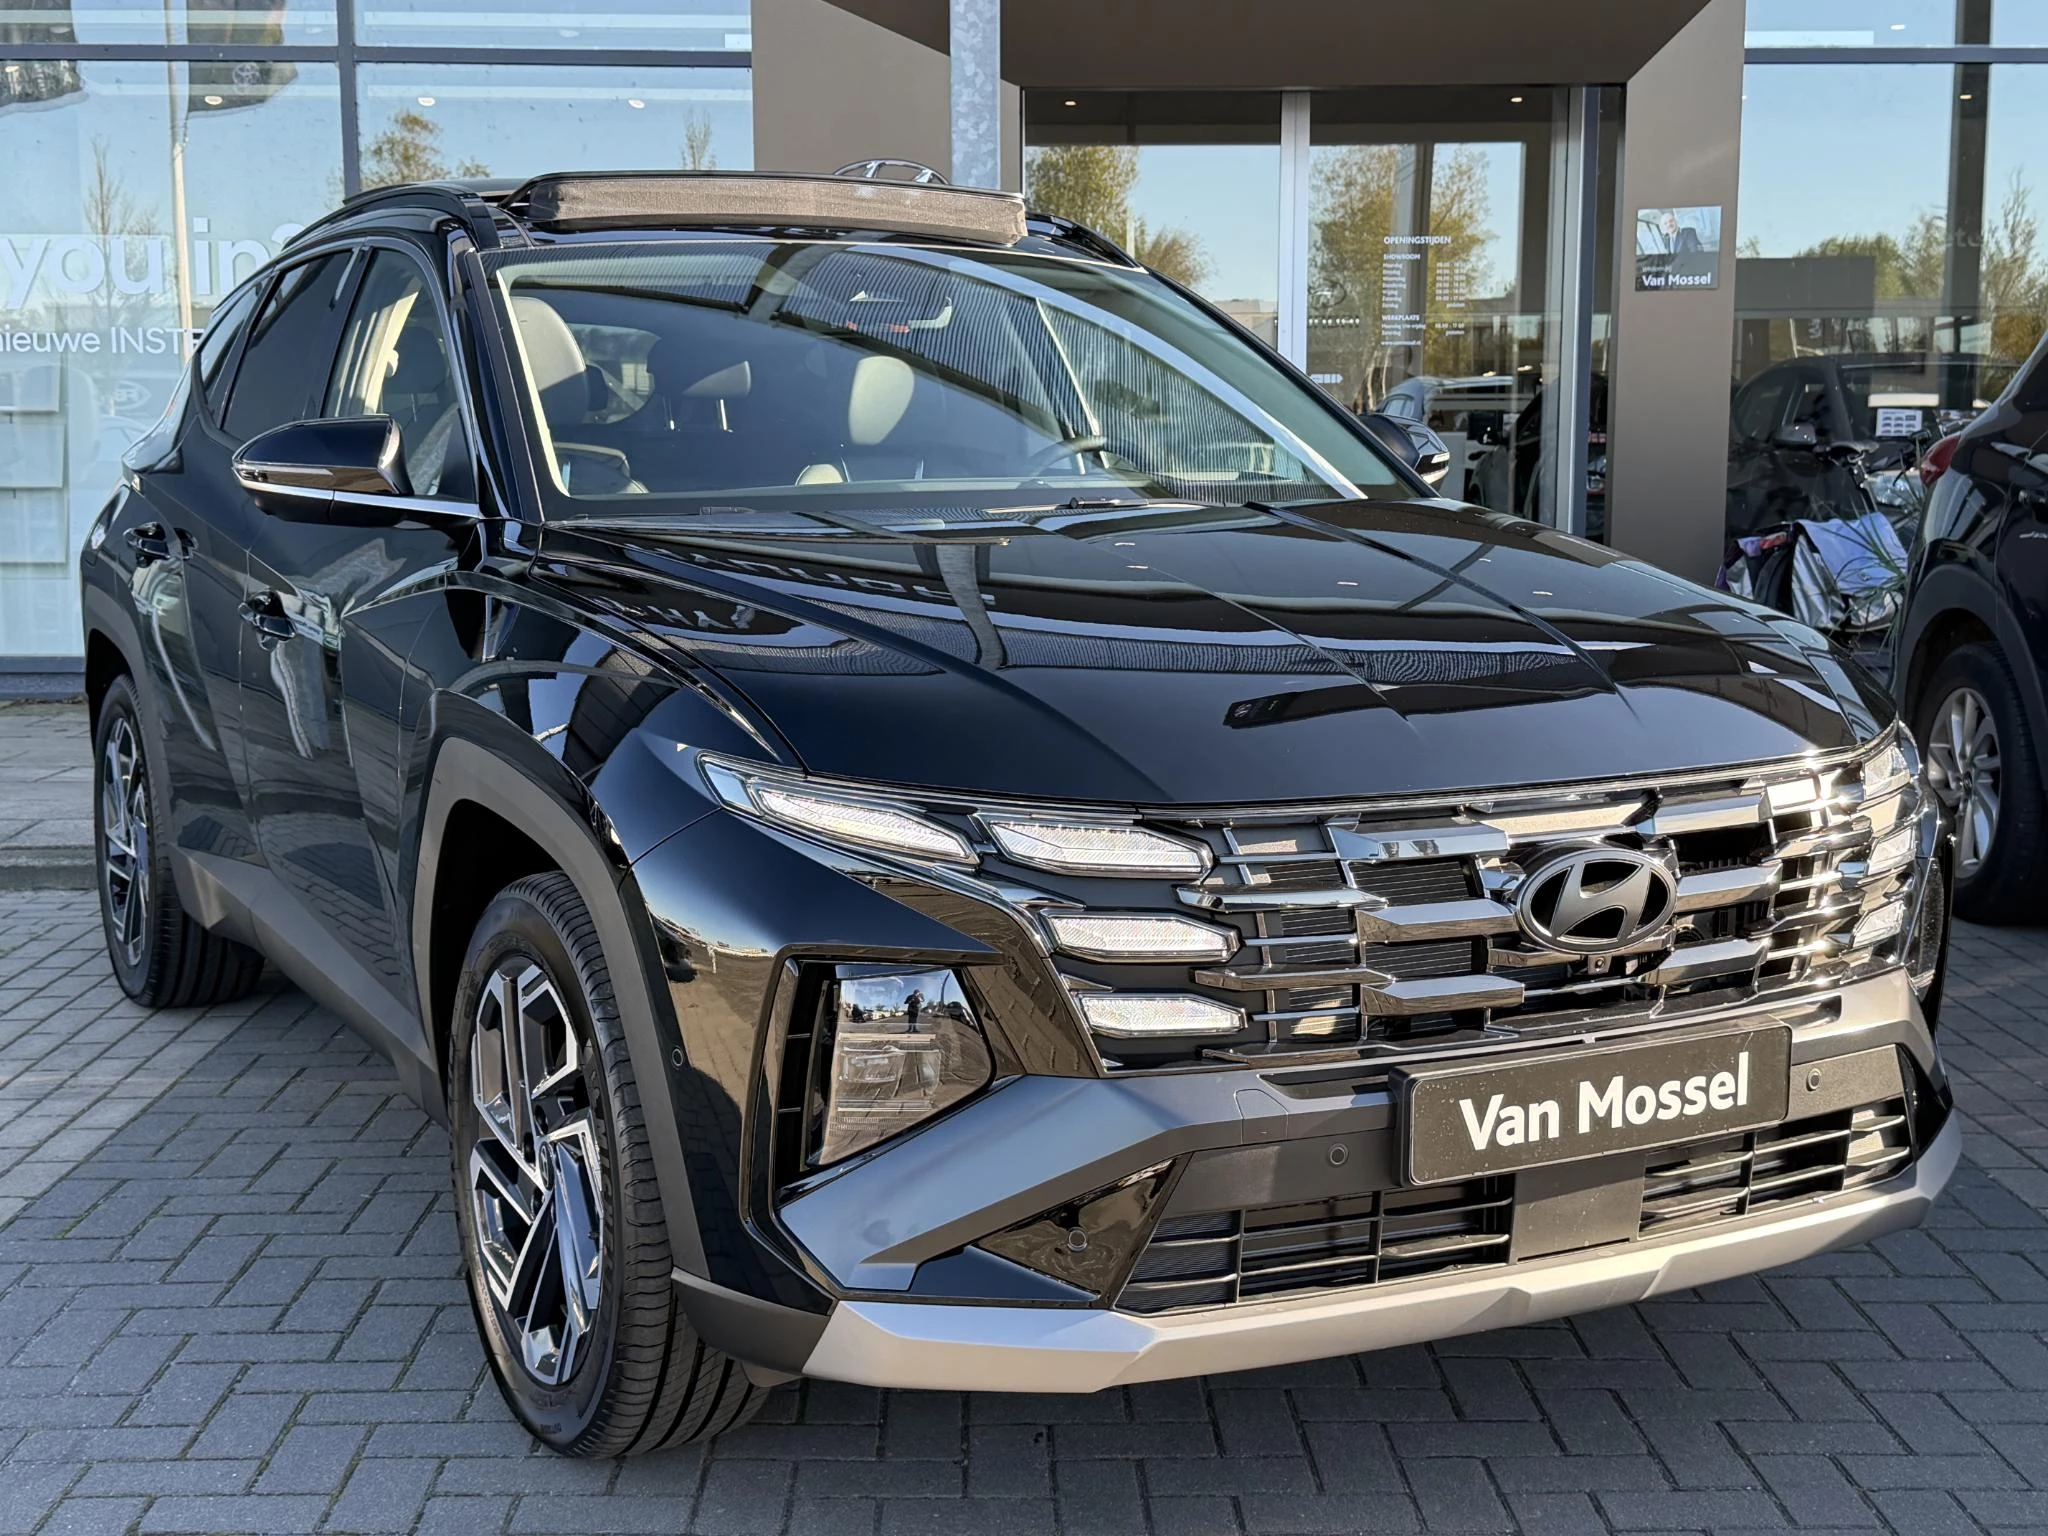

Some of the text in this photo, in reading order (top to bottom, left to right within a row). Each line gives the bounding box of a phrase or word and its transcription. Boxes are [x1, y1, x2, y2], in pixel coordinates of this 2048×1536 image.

[1384, 236, 1451, 245] OPENINGSTIJDEN
[0, 216, 305, 310] you in
[1642, 272, 1711, 286] Van Mossel
[0, 323, 101, 353] ieuwe
[1458, 1051, 1750, 1151] Van Mossel
